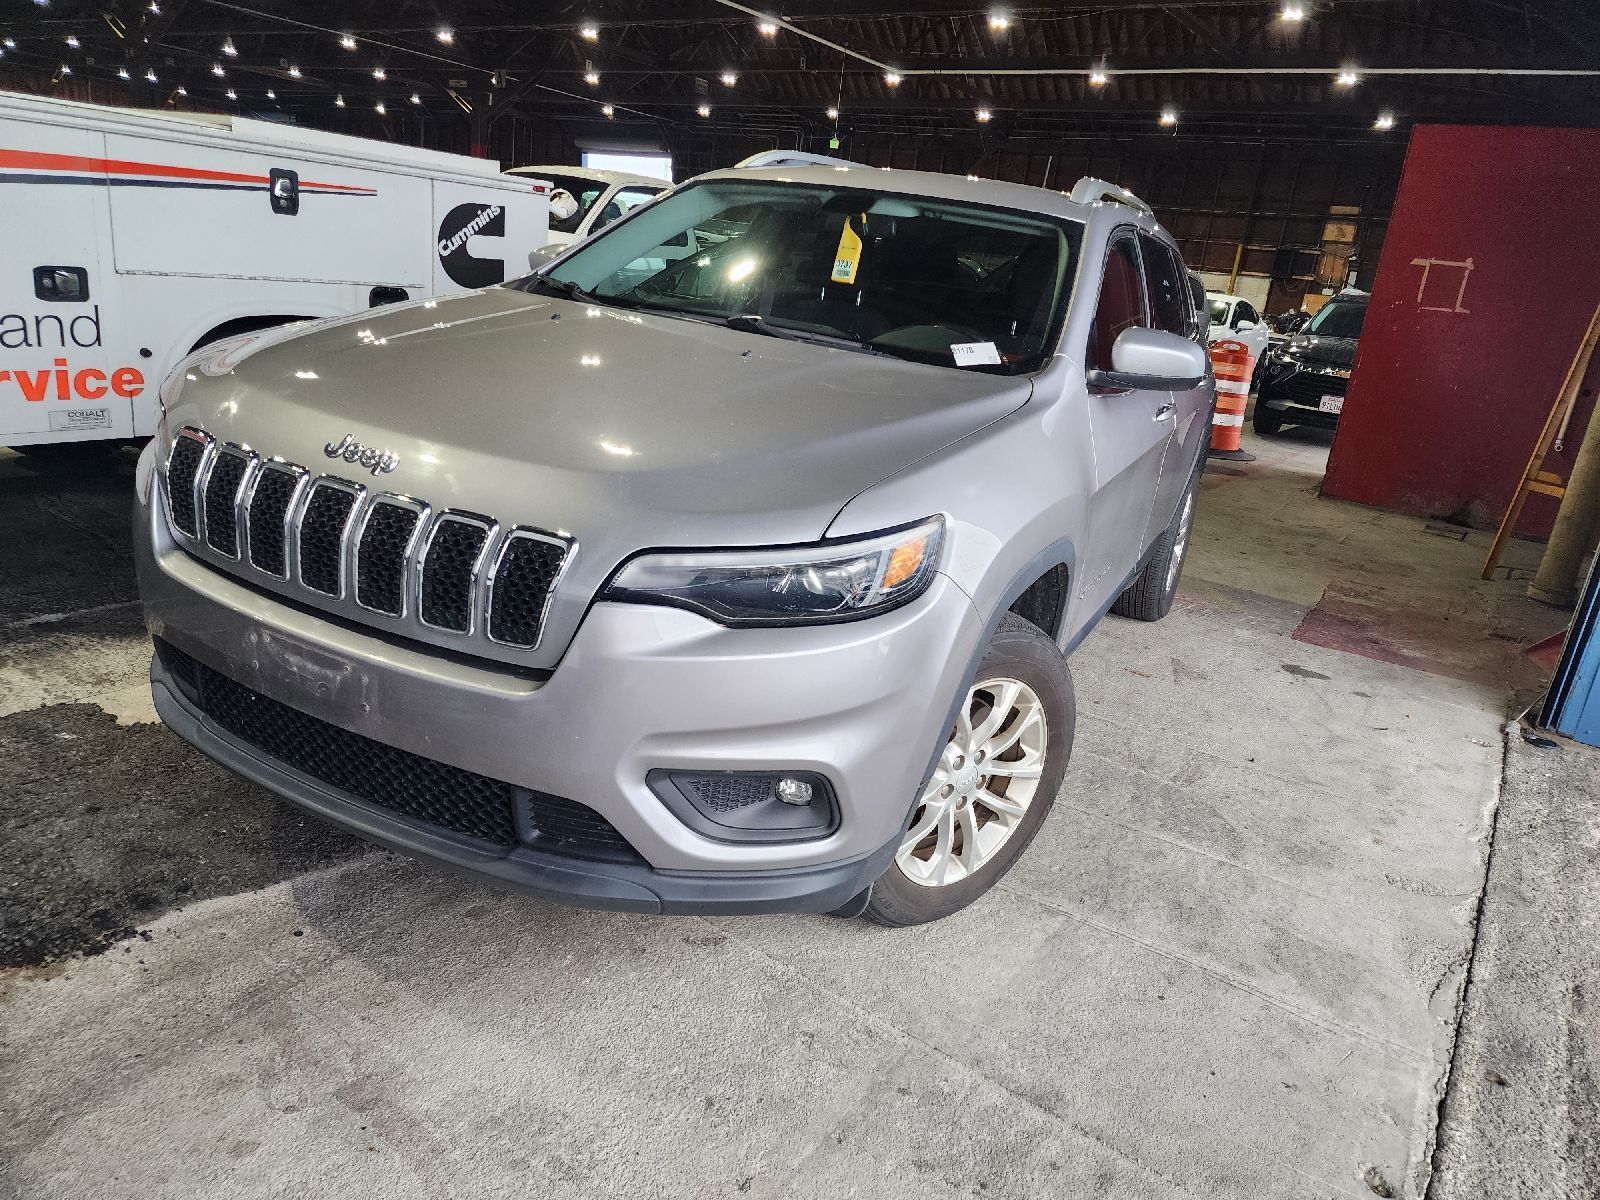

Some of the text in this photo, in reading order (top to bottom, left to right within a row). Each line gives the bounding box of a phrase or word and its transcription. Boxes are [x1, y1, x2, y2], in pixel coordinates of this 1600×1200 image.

[438, 205, 501, 257] Cummins
[0, 305, 102, 348] and
[324, 433, 400, 477] Jeep
